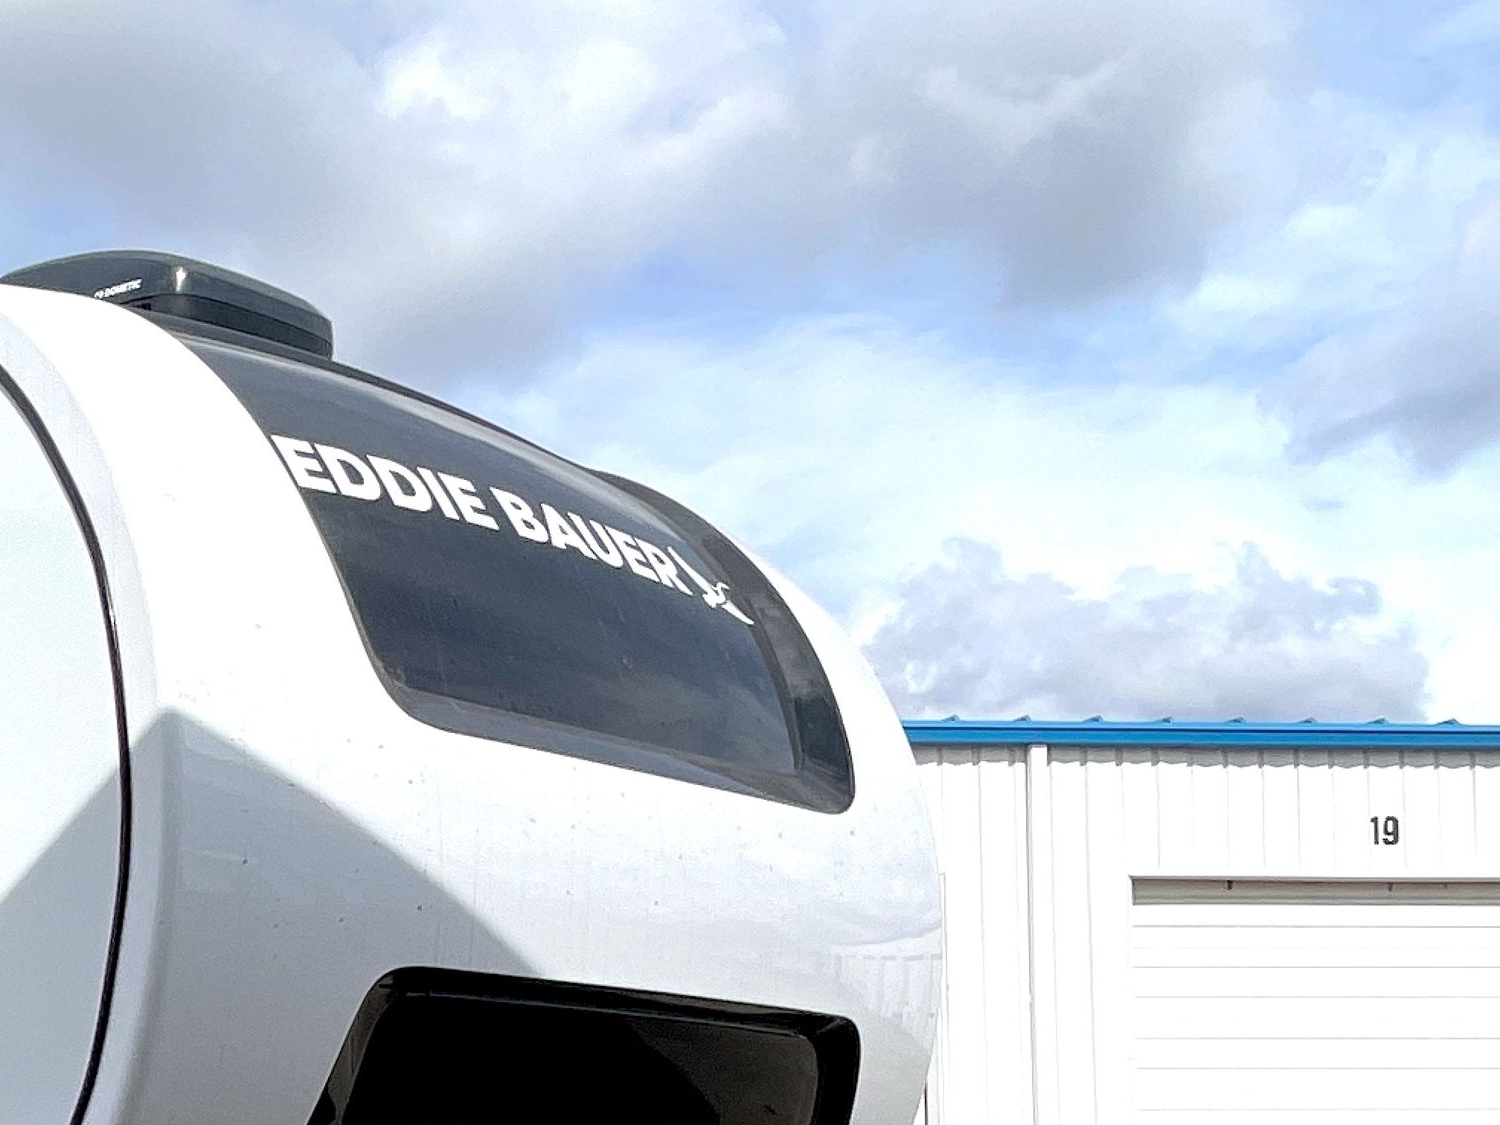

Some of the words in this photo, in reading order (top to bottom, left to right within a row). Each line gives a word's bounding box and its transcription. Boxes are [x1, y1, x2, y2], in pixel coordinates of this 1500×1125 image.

[270, 434, 500, 530] EDDIE
[490, 486, 694, 597] BAUER
[1370, 815, 1399, 846] 19
